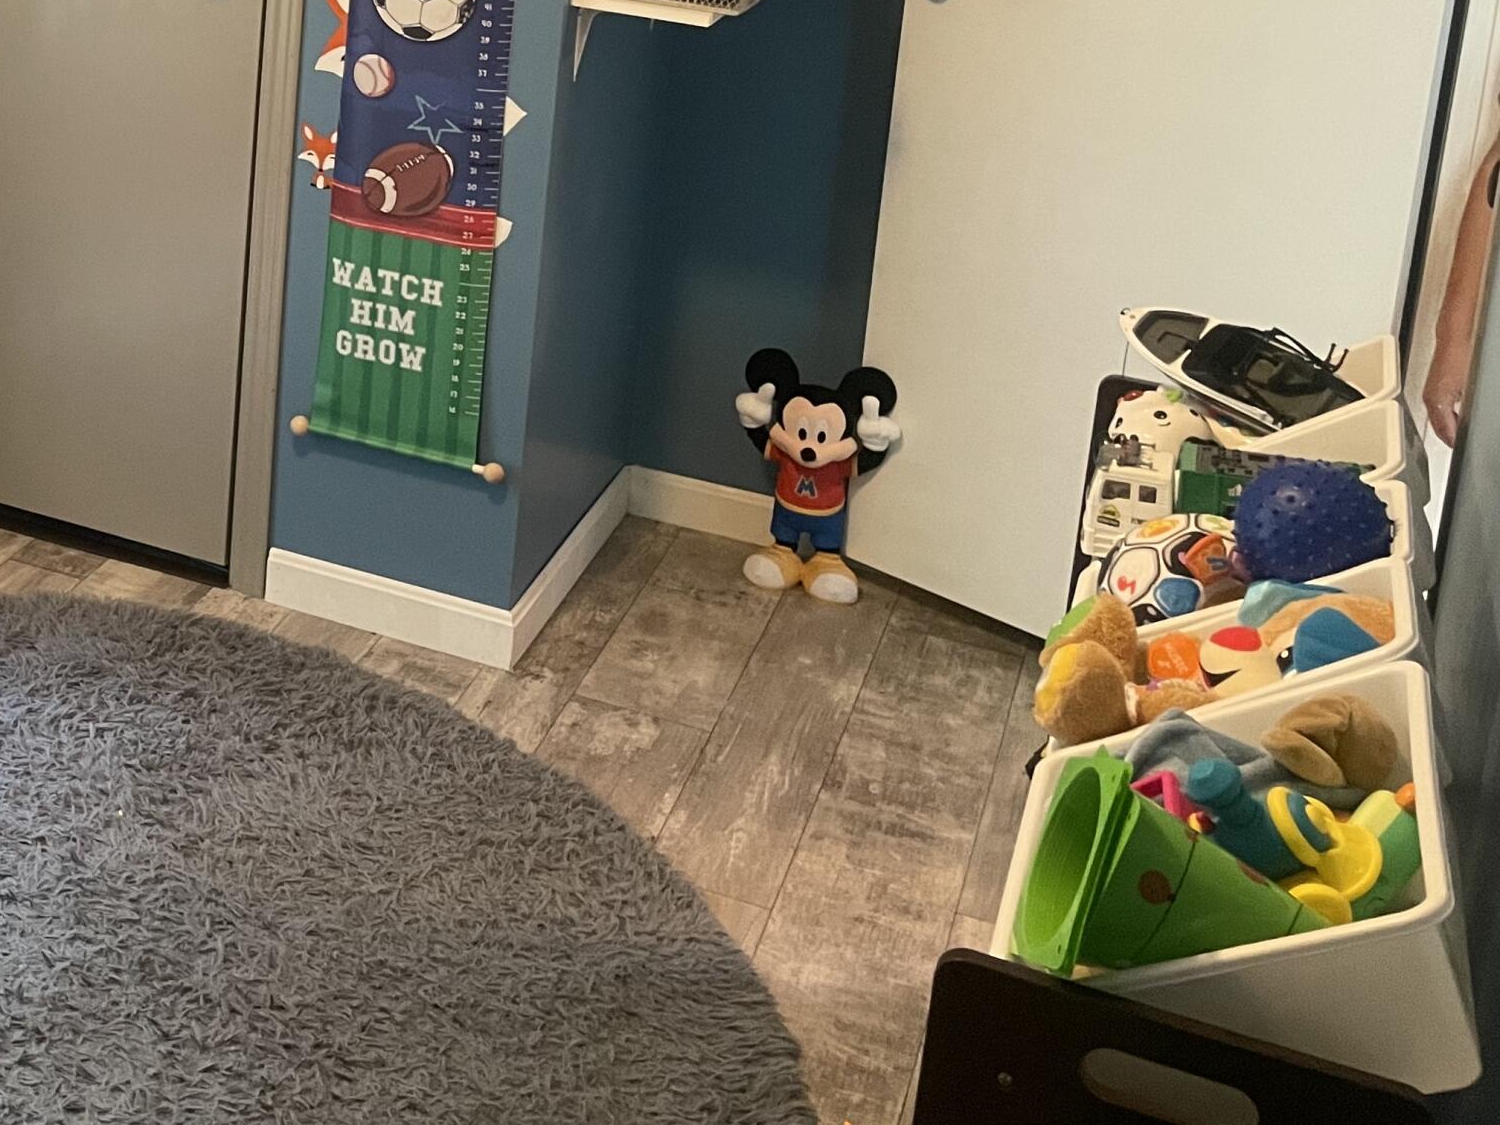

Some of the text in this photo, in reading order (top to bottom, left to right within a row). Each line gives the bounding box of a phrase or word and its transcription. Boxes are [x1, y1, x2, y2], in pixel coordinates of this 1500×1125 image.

[481, 19, 493, 28] 40
[480, 36, 490, 44] 39
[478, 69, 487, 77] 37
[474, 101, 484, 110] 35
[472, 118, 483, 126] 34
[471, 134, 481, 143] 33
[469, 150, 480, 159] 32
[467, 183, 478, 191] 30
[465, 199, 476, 207] 29
[462, 232, 474, 240] 27
[459, 264, 470, 272] 25
[332, 257, 444, 307] WATCH
[456, 295, 468, 304] 23
[349, 298, 416, 335] HIM
[455, 311, 466, 320] 22
[336, 329, 427, 372] GROW
[452, 343, 464, 351] 20
[450, 390, 458, 399] 17
[794, 475, 818, 499] M
